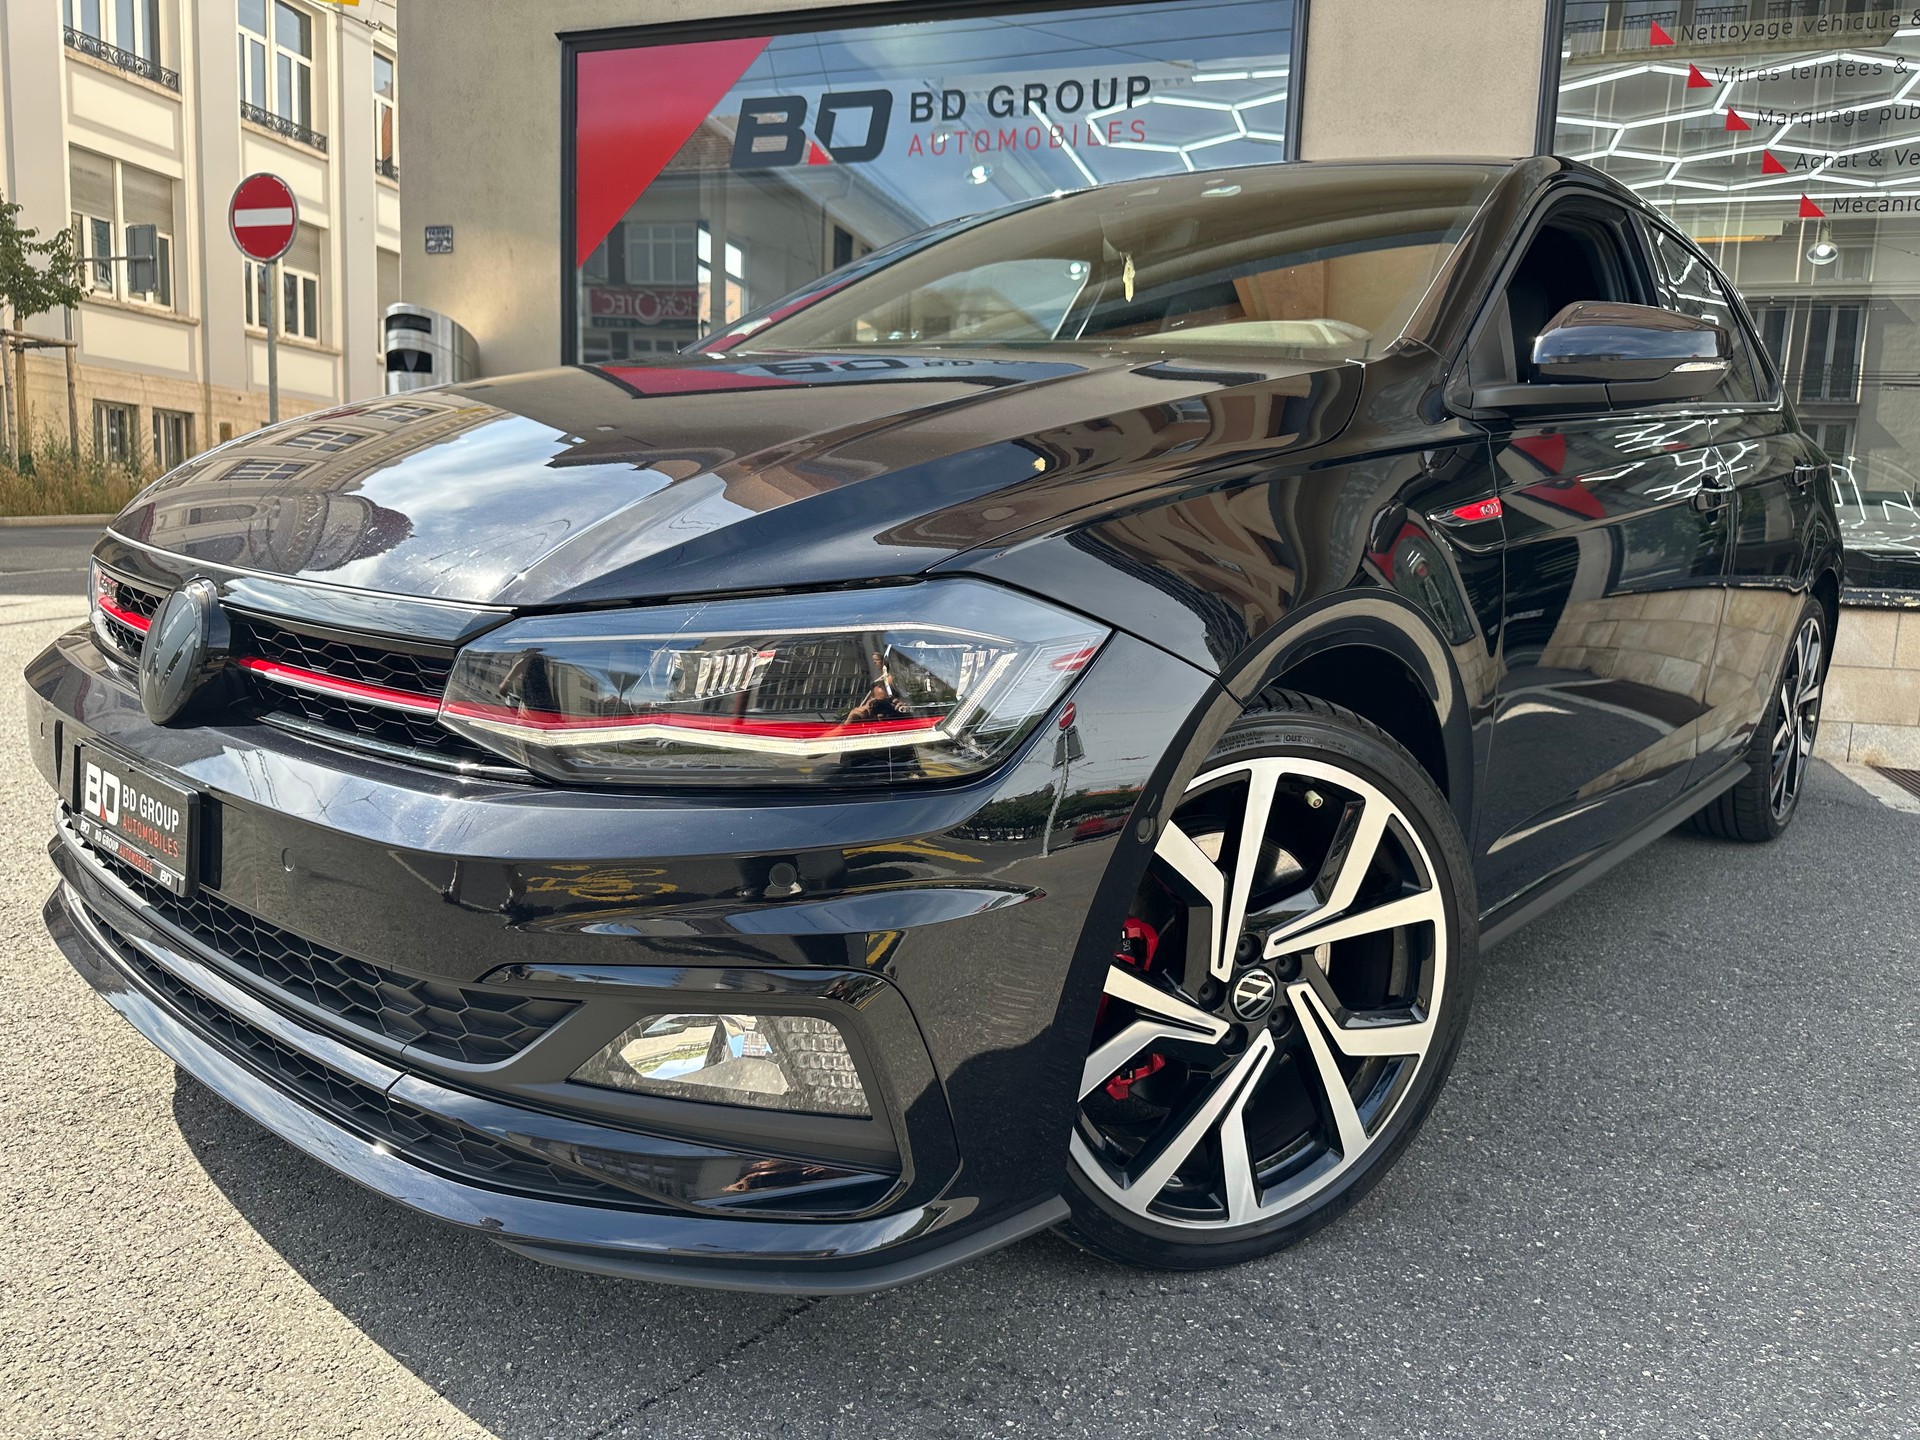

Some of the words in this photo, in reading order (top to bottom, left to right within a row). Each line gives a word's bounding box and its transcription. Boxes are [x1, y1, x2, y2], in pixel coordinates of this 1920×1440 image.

[1681, 22, 1793, 42] Nettoyage
[1803, 11, 1901, 33] véhicule
[1715, 66, 1780, 84] Vitres
[1791, 60, 1883, 81] teintées
[1893, 56, 1908, 74] &
[910, 89, 967, 124] BD
[987, 75, 1151, 118] GROUP
[1757, 109, 1869, 128] Marquage
[729, 89, 893, 169] BD
[907, 120, 1147, 158] AUTOMOBILES
[1794, 153, 1858, 170] Achat
[1868, 150, 1882, 167] &
[84, 761, 121, 827] BD
[122, 784, 137, 811] BD
[140, 793, 180, 833] GROUP
[102, 835, 119, 852] GROUP
[118, 843, 154, 874] AUTOMOBILES
[122, 814, 179, 858] AUTOMOBILES
